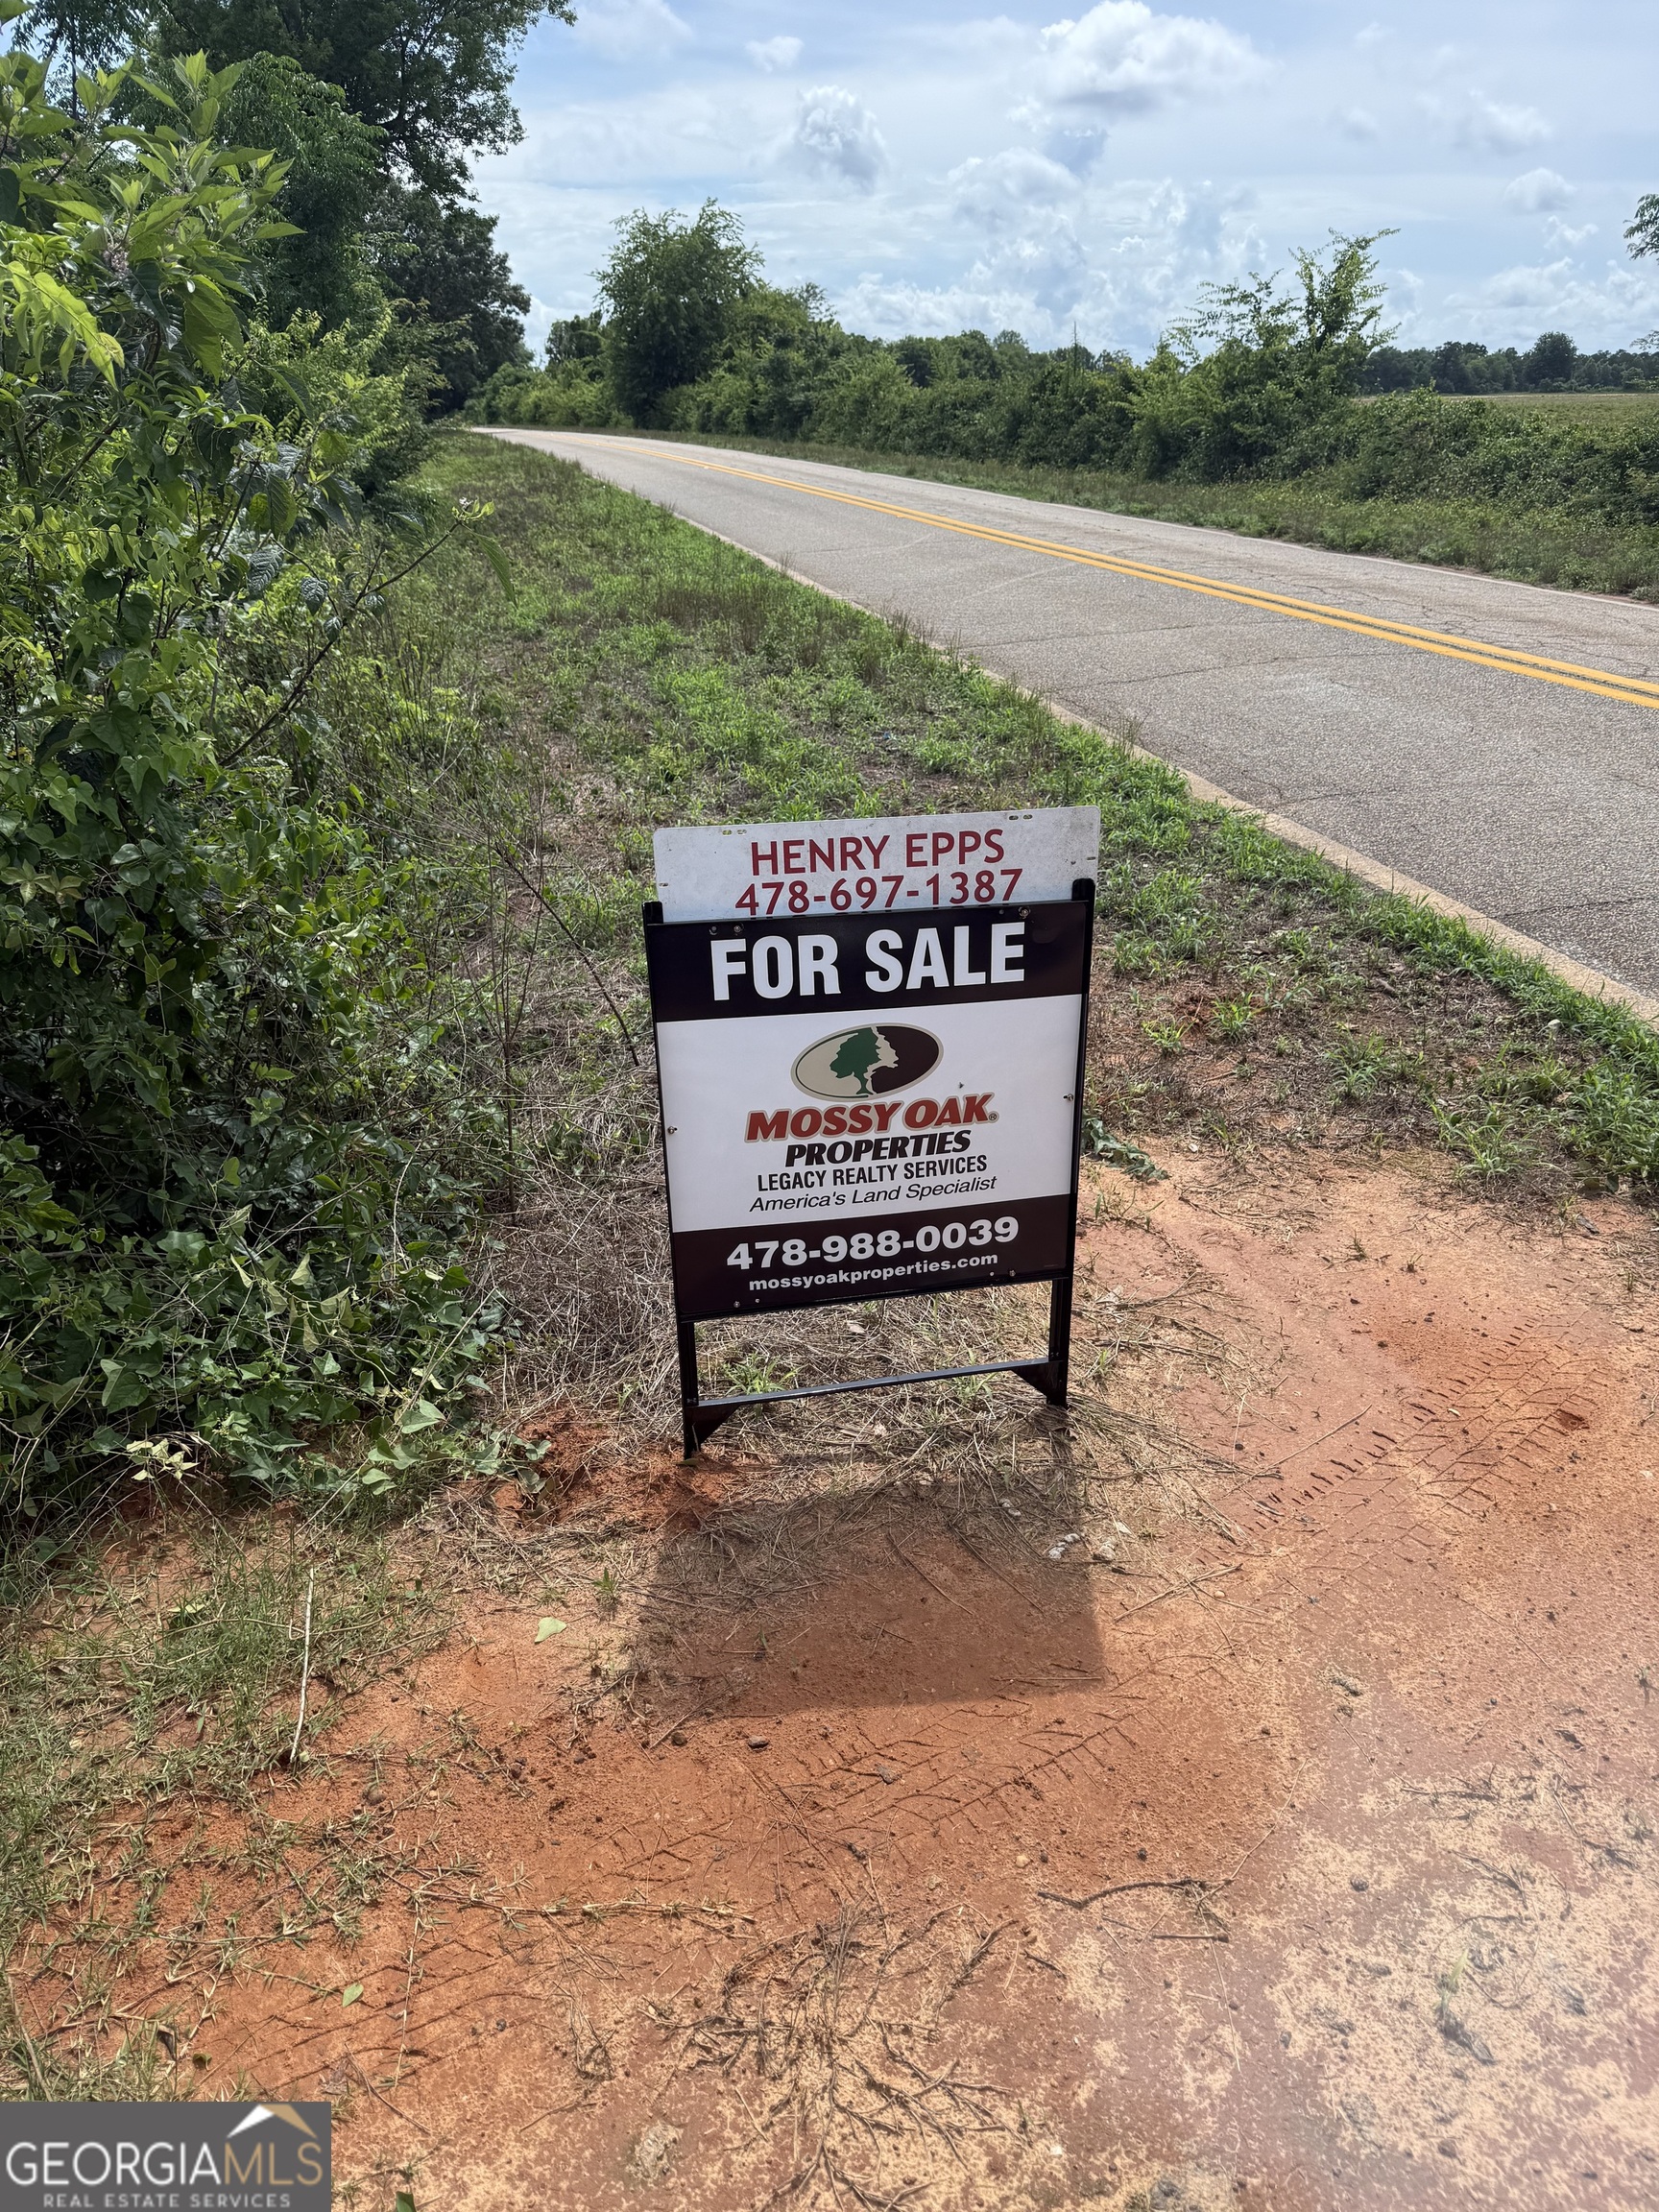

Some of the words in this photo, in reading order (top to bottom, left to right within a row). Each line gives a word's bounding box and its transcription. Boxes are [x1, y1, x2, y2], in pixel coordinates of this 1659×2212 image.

[751, 834, 890, 876] HENRY
[905, 829, 1004, 868] EPPS
[734, 868, 1022, 917] 478-697-1387
[710, 934, 841, 1001] FOR
[865, 922, 1025, 993] SALE
[745, 1101, 903, 1142] MOSSY
[784, 1130, 972, 1166] PROPERTIES
[757, 1168, 827, 1192] LEGACY
[832, 1164, 899, 1187] REALTY
[903, 1154, 988, 1180] SERVICES
[749, 1191, 847, 1213] America's
[852, 1186, 902, 1204] Land
[905, 1175, 998, 1203] Specialist
[726, 1216, 1020, 1270] 478-988-0039
[749, 1254, 998, 1291] mossyoakproperties.com
